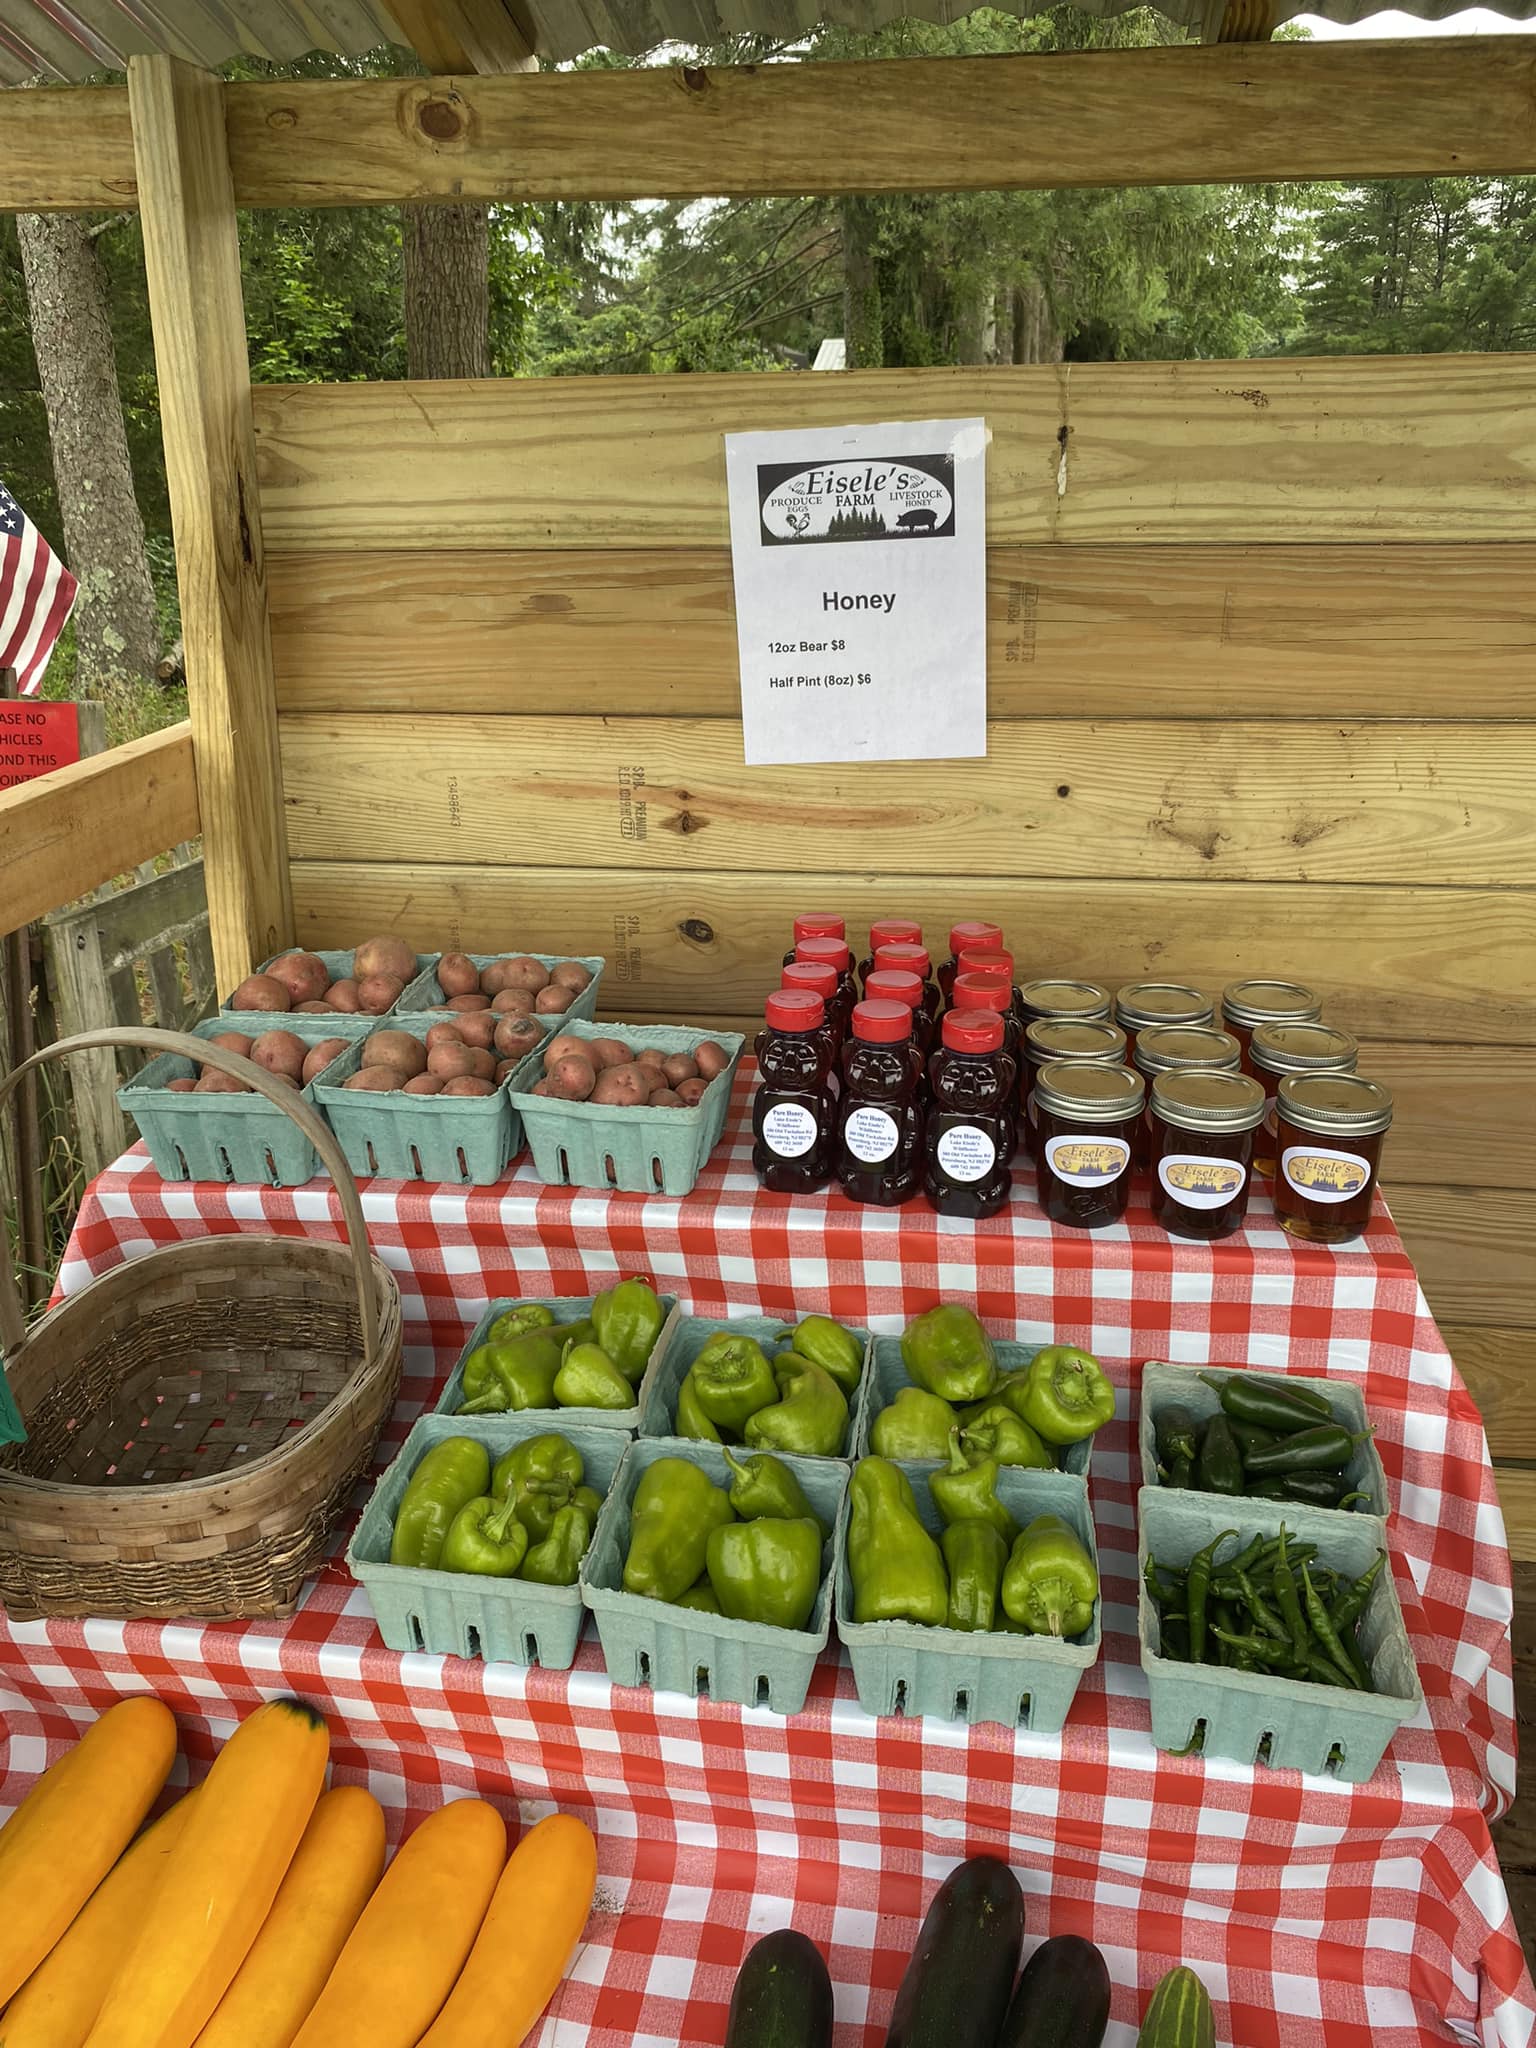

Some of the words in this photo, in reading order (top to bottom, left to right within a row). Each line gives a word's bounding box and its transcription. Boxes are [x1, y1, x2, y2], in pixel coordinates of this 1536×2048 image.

[806, 467, 910, 495] Eisele's
[771, 496, 823, 508] PRODUCE
[835, 493, 875, 507] FARM
[889, 489, 943, 501] LIVESTOCK
[905, 499, 933, 508] HONEY
[822, 591, 896, 614] Honey
[768, 642, 796, 653] 12oz
[799, 641, 828, 652] Bear
[831, 639, 846, 652] $8
[769, 676, 794, 688] Half
[797, 675, 821, 687] Pint
[824, 674, 854, 688] (8oz)
[857, 673, 872, 685] $6
[26, 713, 46, 726] NO
[28, 754, 57, 766] THIS
[869, 1115, 886, 1123] Honey
[1071, 1145, 1114, 1158] Eisele's
[1184, 1165, 1230, 1178] Eisele's
[1305, 1158, 1352, 1174] Eisele's
